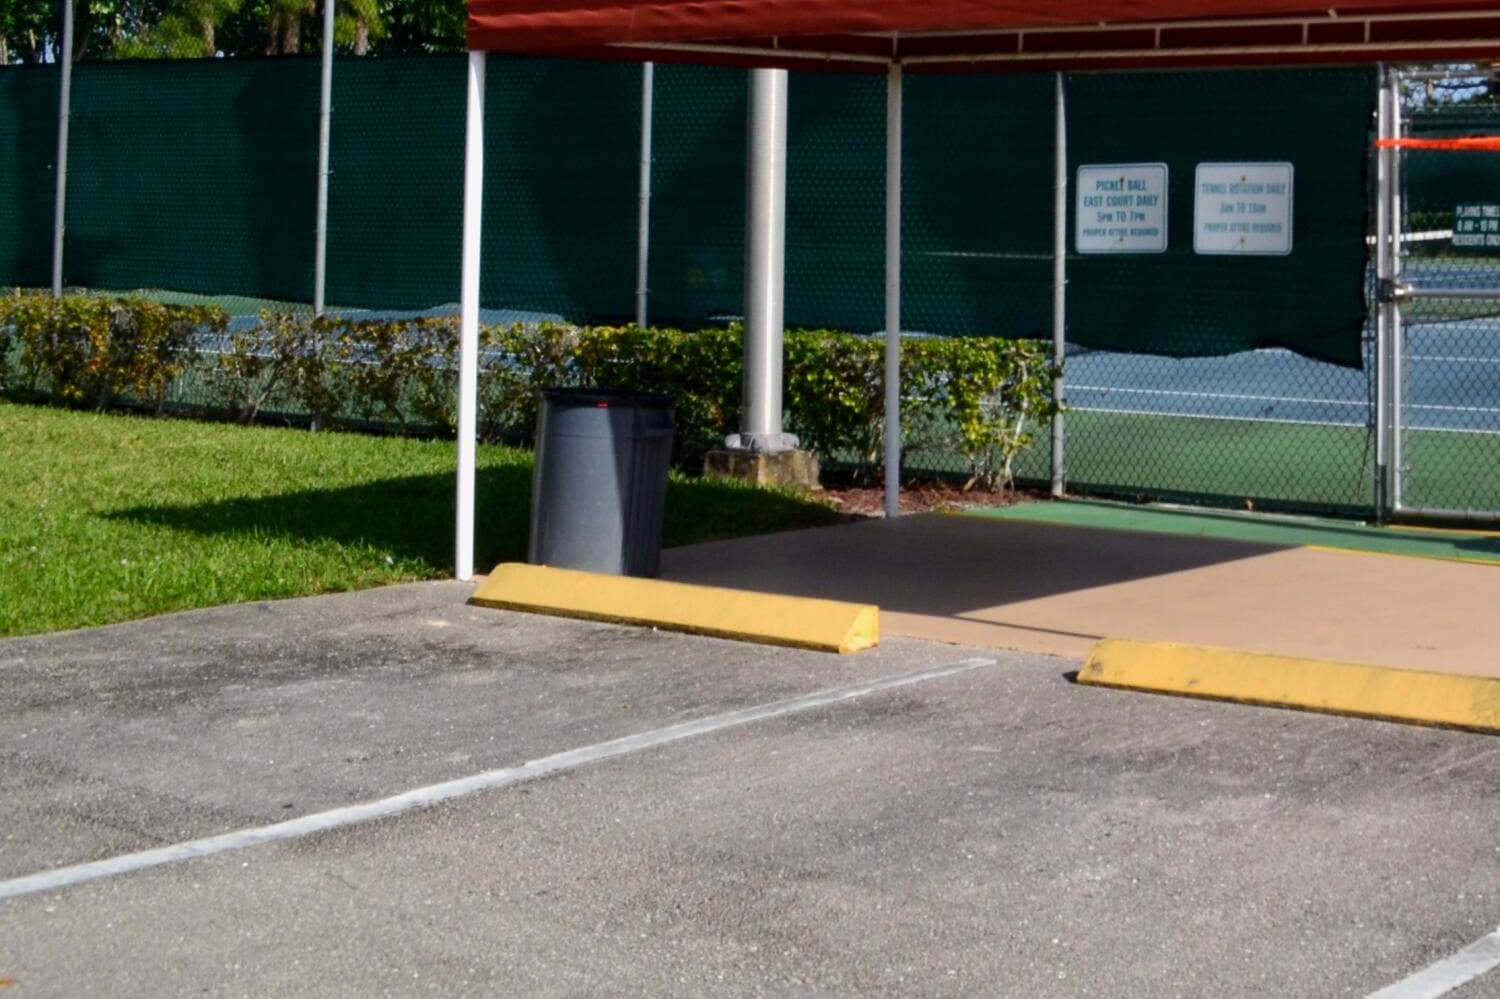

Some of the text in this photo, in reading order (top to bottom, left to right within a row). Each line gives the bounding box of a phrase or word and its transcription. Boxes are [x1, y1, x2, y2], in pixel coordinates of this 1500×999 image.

[1127, 179, 1146, 191] BALL
[1201, 183, 1227, 195] TENNIS
[1083, 194, 1159, 207] EAST COURT DAILY
[1236, 202, 1246, 214] TO
[1456, 205, 1481, 218] PLAYING
[1115, 210, 1127, 222] TO
